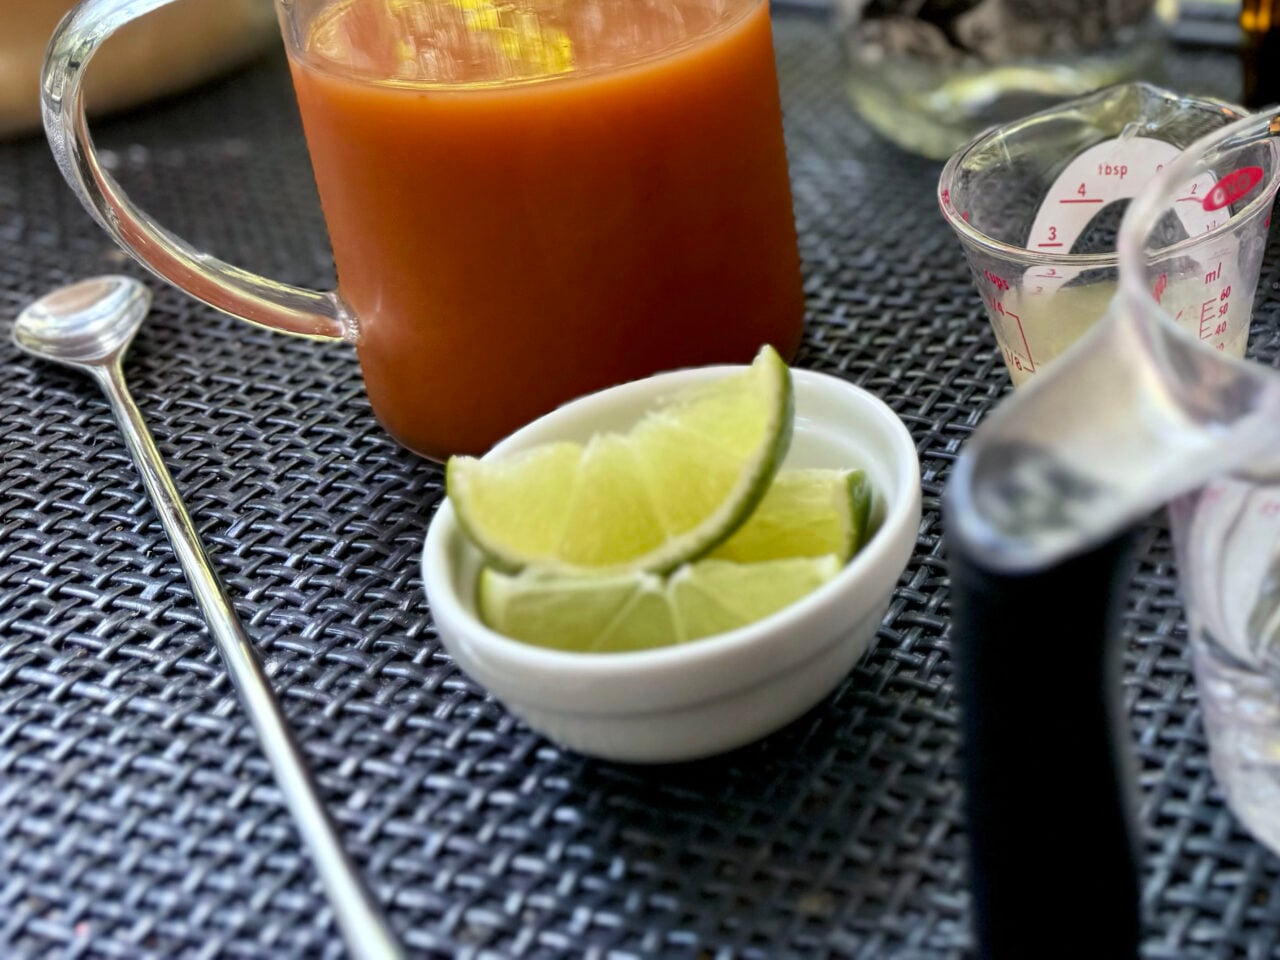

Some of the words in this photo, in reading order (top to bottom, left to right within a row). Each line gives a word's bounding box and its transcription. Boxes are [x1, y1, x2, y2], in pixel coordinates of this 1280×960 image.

[1098, 163, 1128, 179] tbsp
[1077, 183, 1086, 197] 4
[1048, 226, 1057, 241] 3
[983, 269, 1010, 291] cups
[1204, 261, 1222, 284] ml
[1220, 285, 1232, 301] 60
[1218, 302, 1229, 318] 50
[1215, 320, 1227, 336] 40
